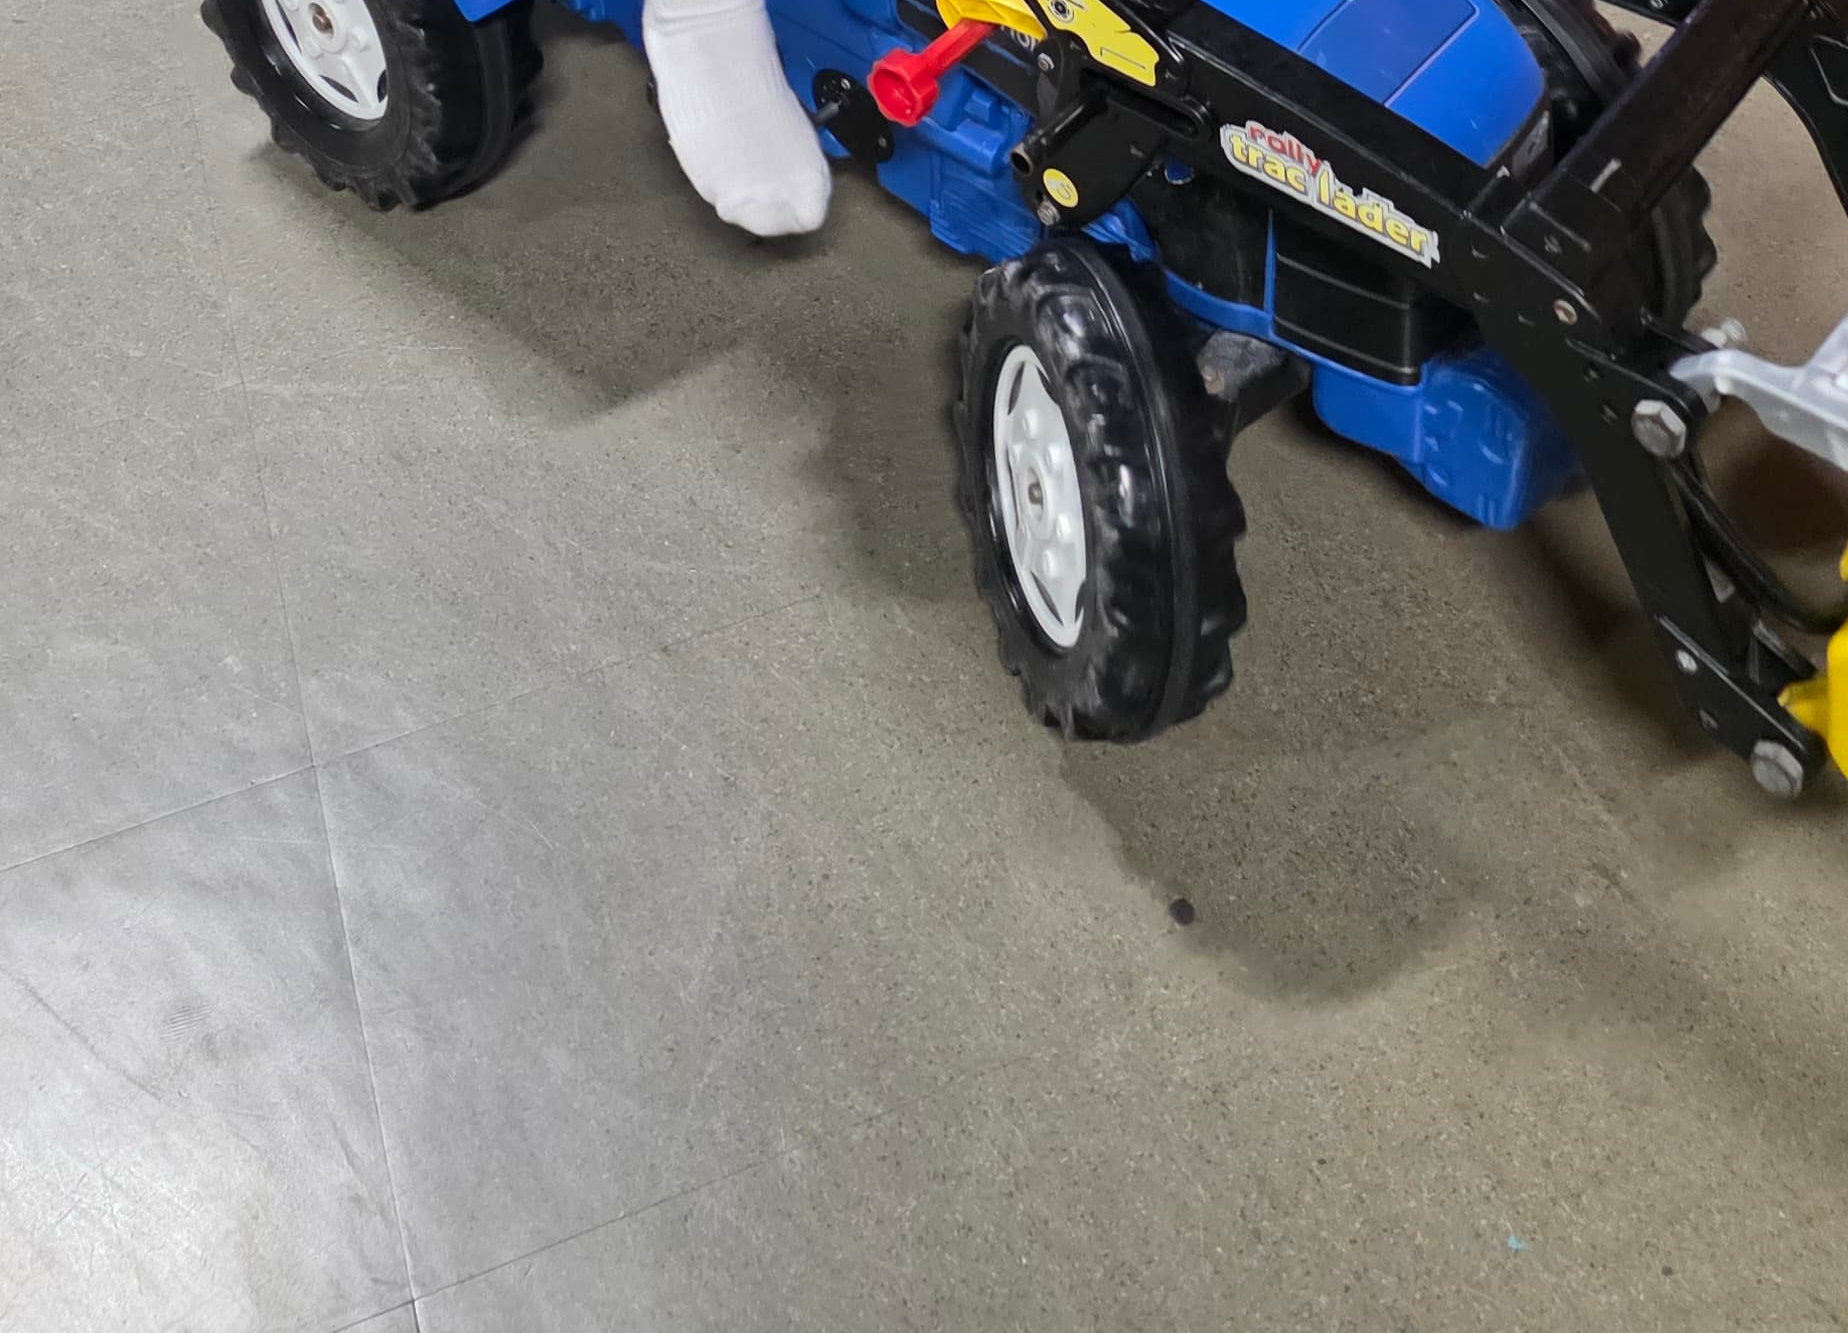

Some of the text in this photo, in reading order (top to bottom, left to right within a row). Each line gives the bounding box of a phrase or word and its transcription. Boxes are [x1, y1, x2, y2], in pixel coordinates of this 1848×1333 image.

[1229, 134, 1428, 254] trac lader
[1249, 125, 1322, 177] rolly
